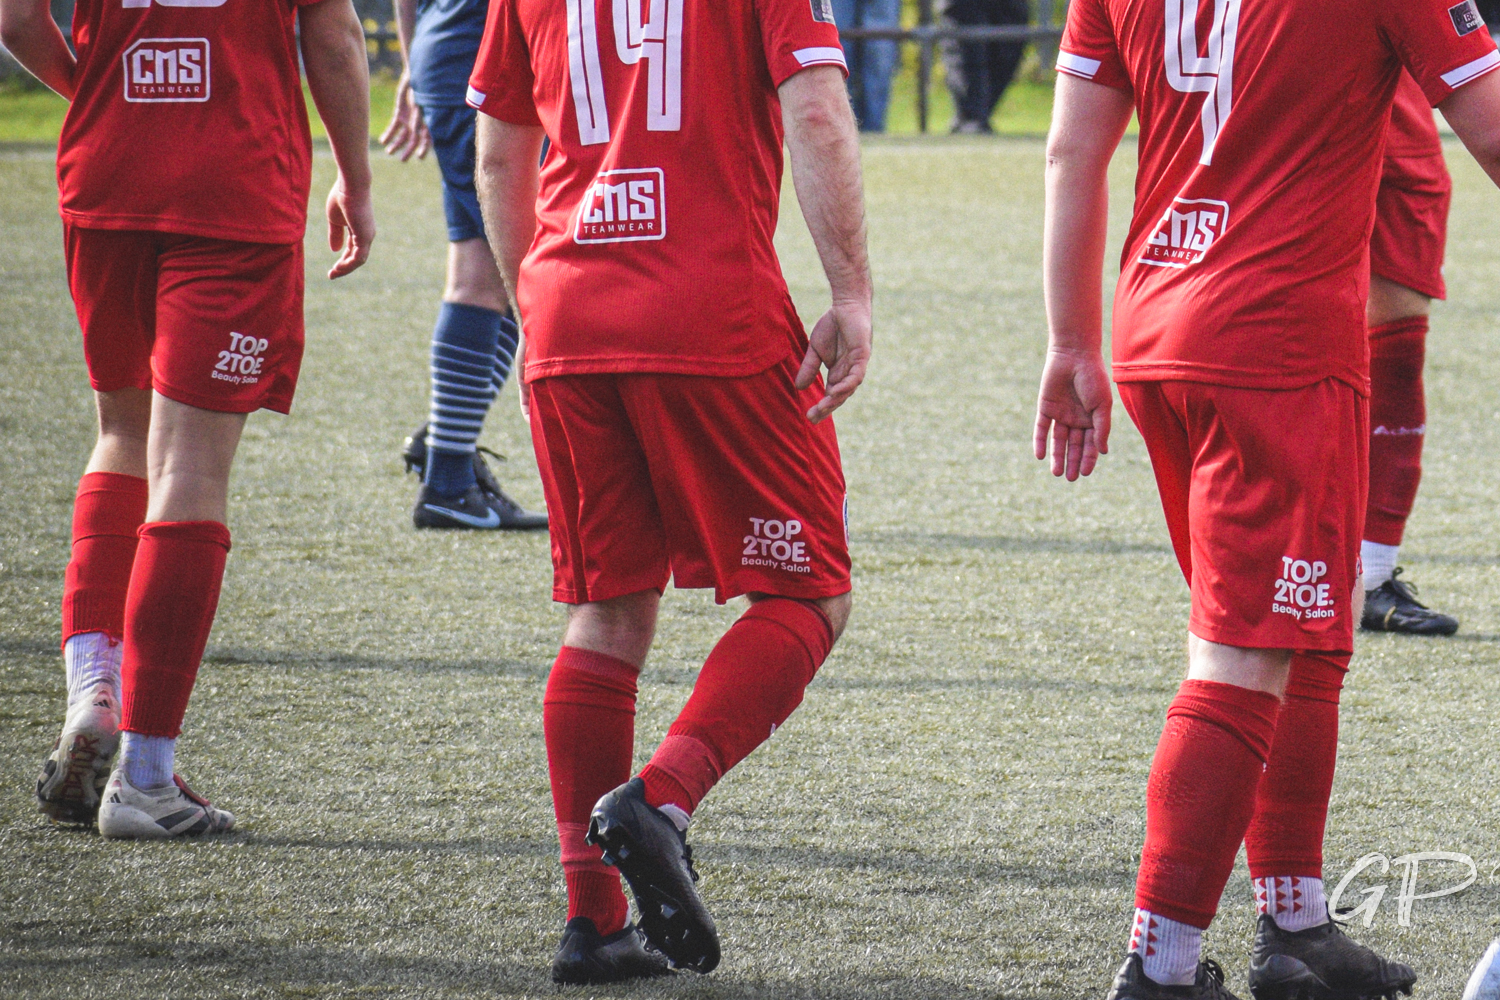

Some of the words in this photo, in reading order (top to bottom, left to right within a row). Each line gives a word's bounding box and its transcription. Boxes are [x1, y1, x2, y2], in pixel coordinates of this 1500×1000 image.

[133, 48, 201, 84] CMS
[583, 180, 655, 223] CMS
[584, 222, 653, 234] TEAMWEAR
[1148, 207, 1218, 252] CMS
[1146, 245, 1200, 261] TEAMWEA
[230, 332, 268, 356] TOP
[749, 517, 801, 540] TOP
[741, 557, 778, 569] Beauty
[780, 561, 811, 573] Salon
[1282, 556, 1327, 583] TOP
[1305, 608, 1334, 618] Salon
